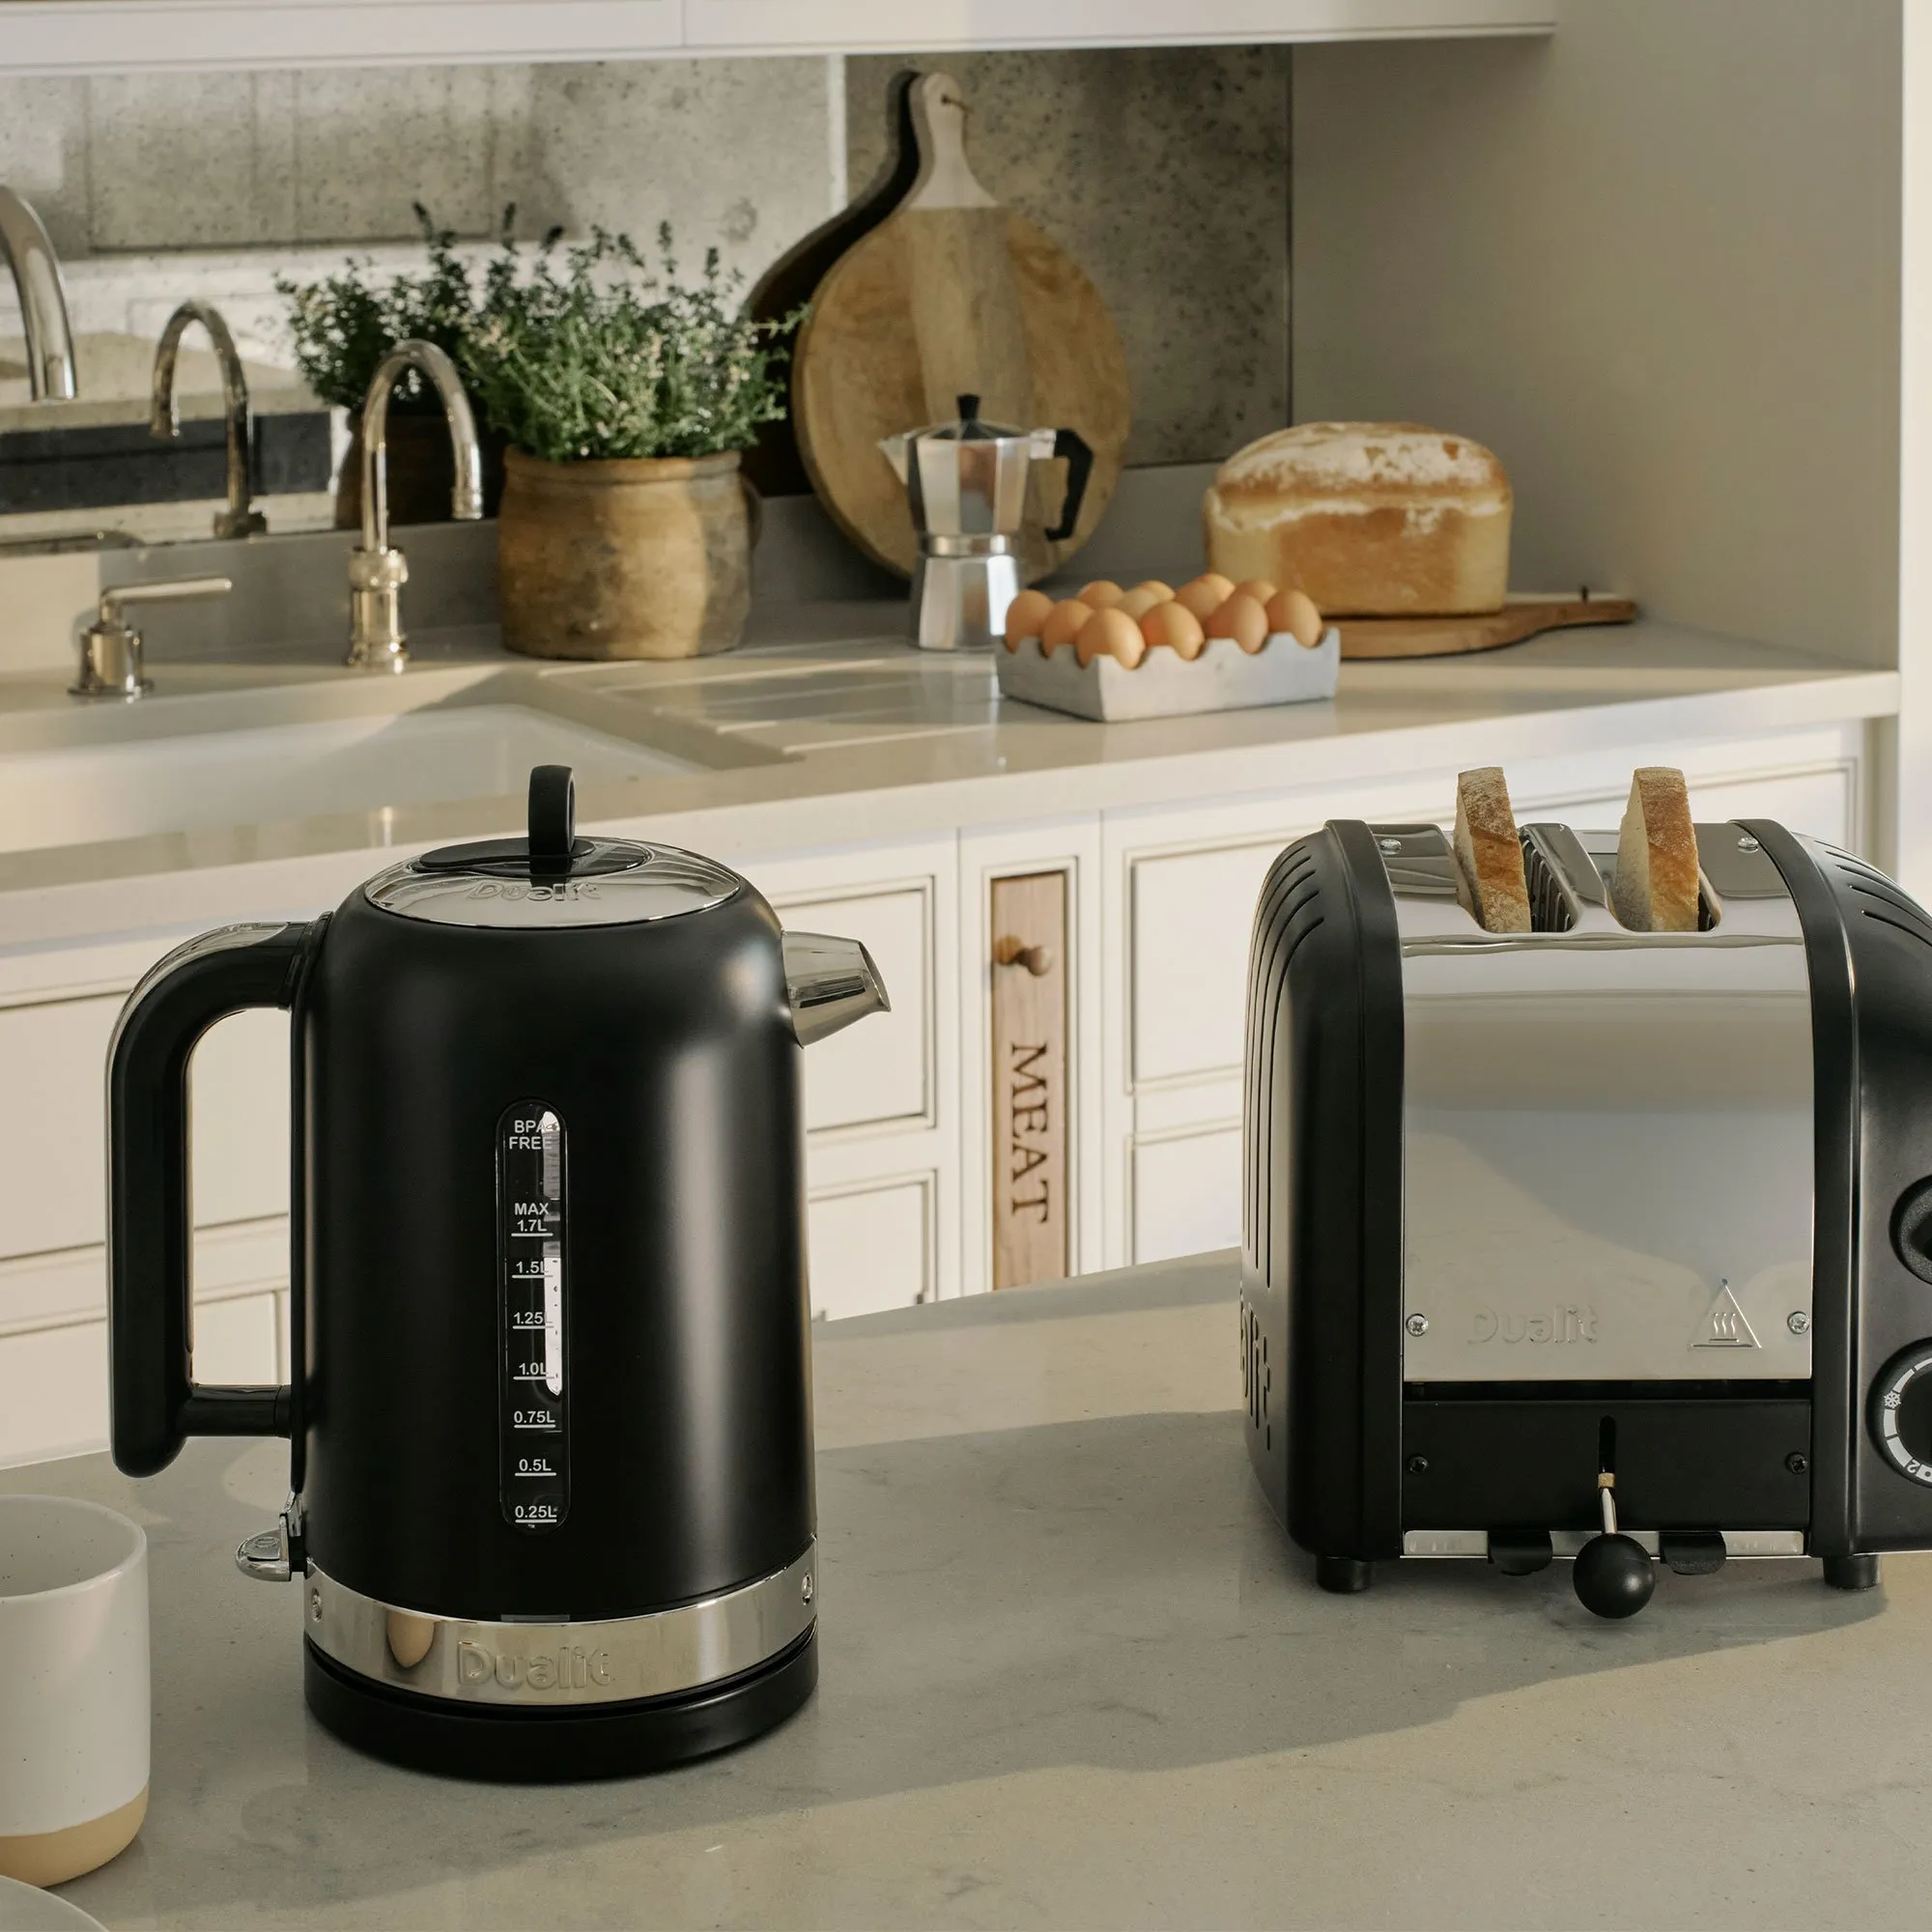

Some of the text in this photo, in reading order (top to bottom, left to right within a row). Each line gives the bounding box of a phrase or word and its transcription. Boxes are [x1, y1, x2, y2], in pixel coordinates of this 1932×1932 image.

[464, 880, 602, 901] Dualit
[514, 1120, 547, 1133] BPA
[1010, 1042, 1049, 1224] MEAT
[509, 1136, 553, 1150] FREE
[514, 1203, 550, 1215] MAX
[517, 1219, 548, 1232] 1.7L
[515, 1261, 549, 1274] 1.5L
[513, 1312, 553, 1324] 1.25L
[1467, 1304, 1599, 1344] Dualit
[519, 1362, 549, 1376] 1.0L
[514, 1410, 555, 1424] 0.75L
[519, 1459, 552, 1471] 0.5L
[1907, 1459, 1920, 1473] 2
[515, 1505, 557, 1518] 0.25L
[457, 1641, 615, 1690] Dualit
